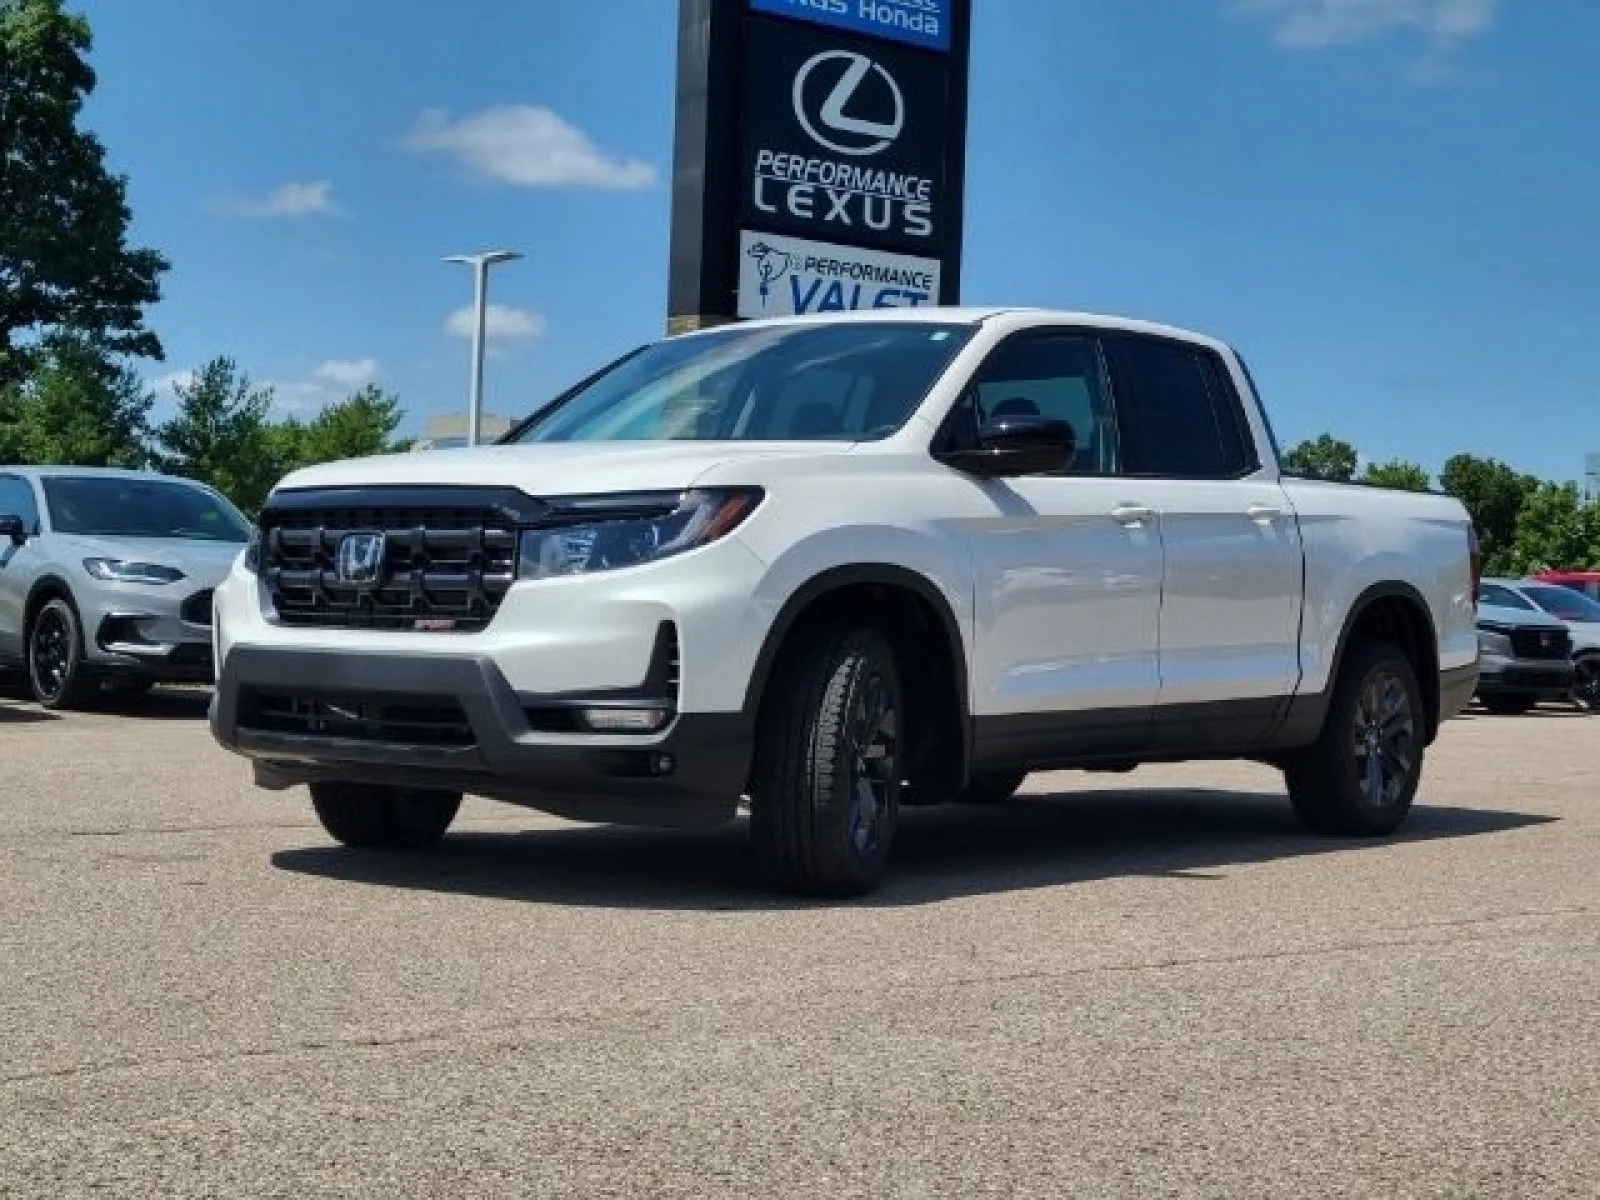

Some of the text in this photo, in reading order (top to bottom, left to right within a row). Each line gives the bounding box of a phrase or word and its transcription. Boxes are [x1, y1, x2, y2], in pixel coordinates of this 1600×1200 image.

[859, 0, 938, 36] Honda
[756, 149, 933, 201] PERFORMANCE
[754, 175, 933, 236] LEXUS
[804, 255, 934, 291] PERFORMANCE
